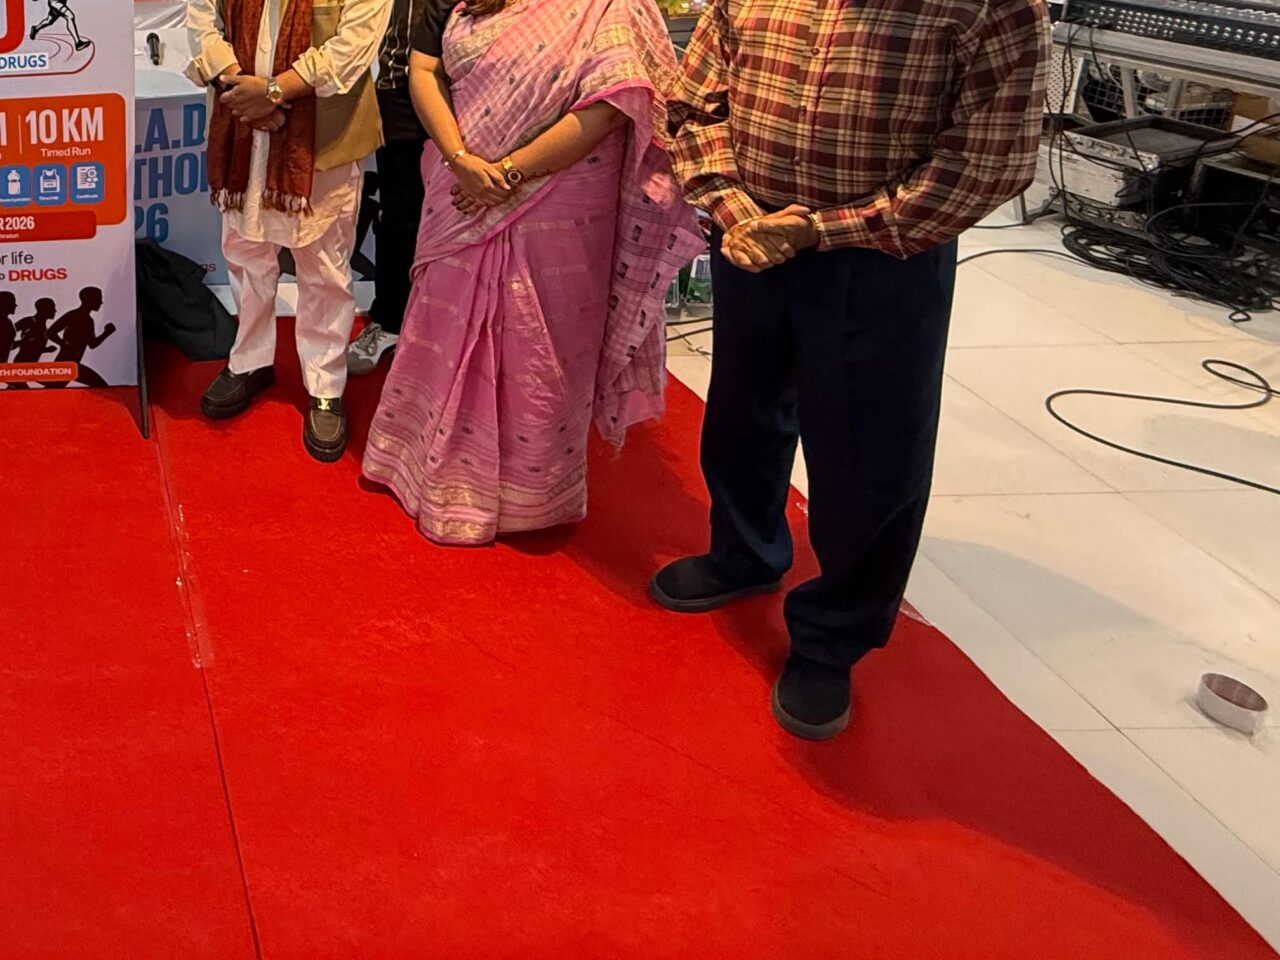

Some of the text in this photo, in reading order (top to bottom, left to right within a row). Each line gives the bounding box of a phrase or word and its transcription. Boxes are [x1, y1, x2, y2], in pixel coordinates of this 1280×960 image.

[25, 106, 104, 145] 10 KM
[40, 146, 91, 158] Timed Run
[6, 216, 35, 230] 2026
[11, 251, 34, 265] life
[8, 268, 68, 282] DRUGS
[11, 367, 72, 376] FOUNDATION
